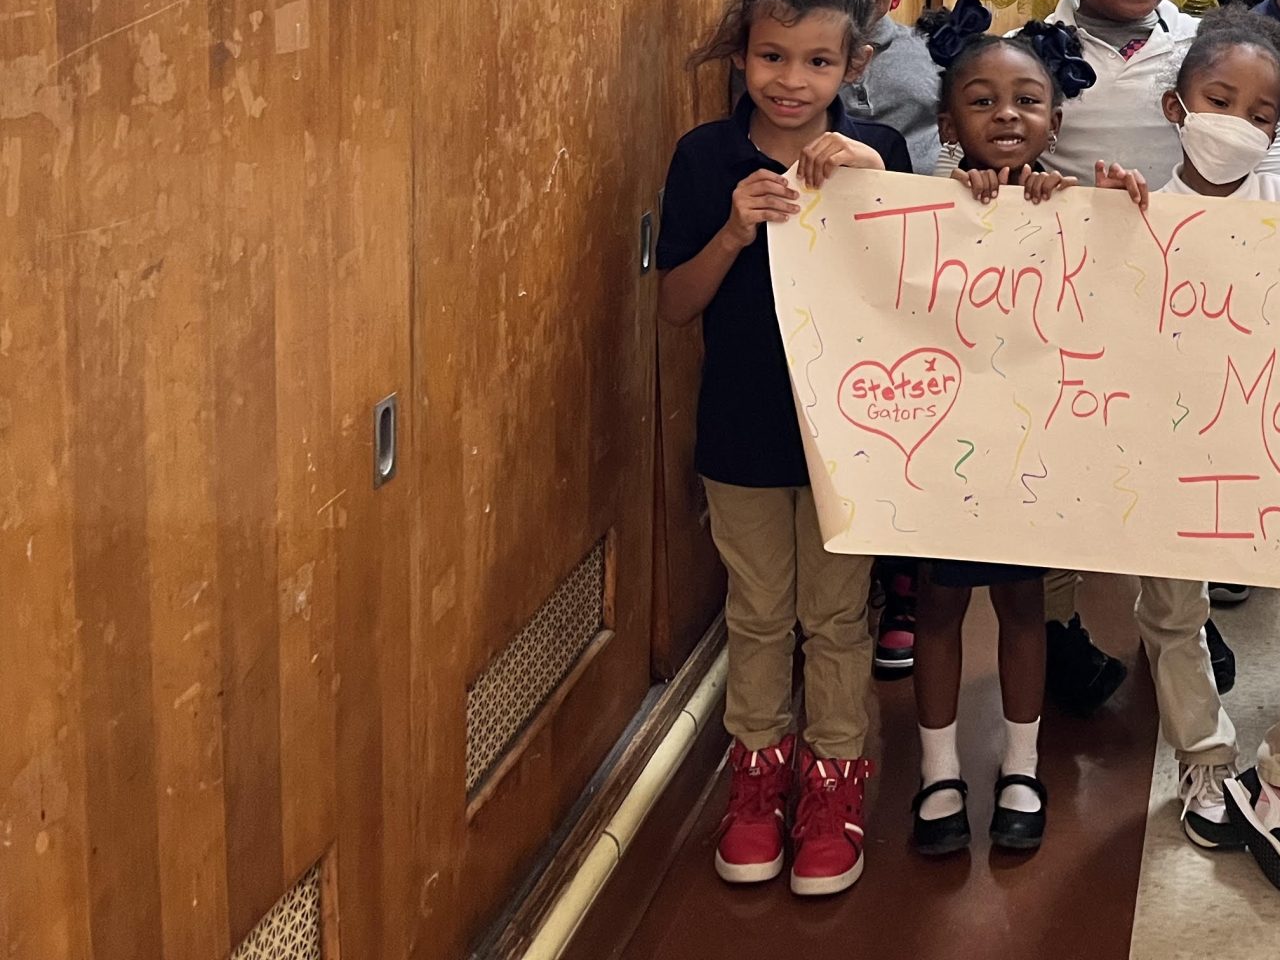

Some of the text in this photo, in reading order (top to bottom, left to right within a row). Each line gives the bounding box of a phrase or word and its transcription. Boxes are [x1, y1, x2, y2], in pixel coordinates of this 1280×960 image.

[854, 202, 1088, 348] Thank
[1138, 206, 1252, 335] You
[867, 403, 937, 423] Gators
[1045, 347, 1130, 430] For
